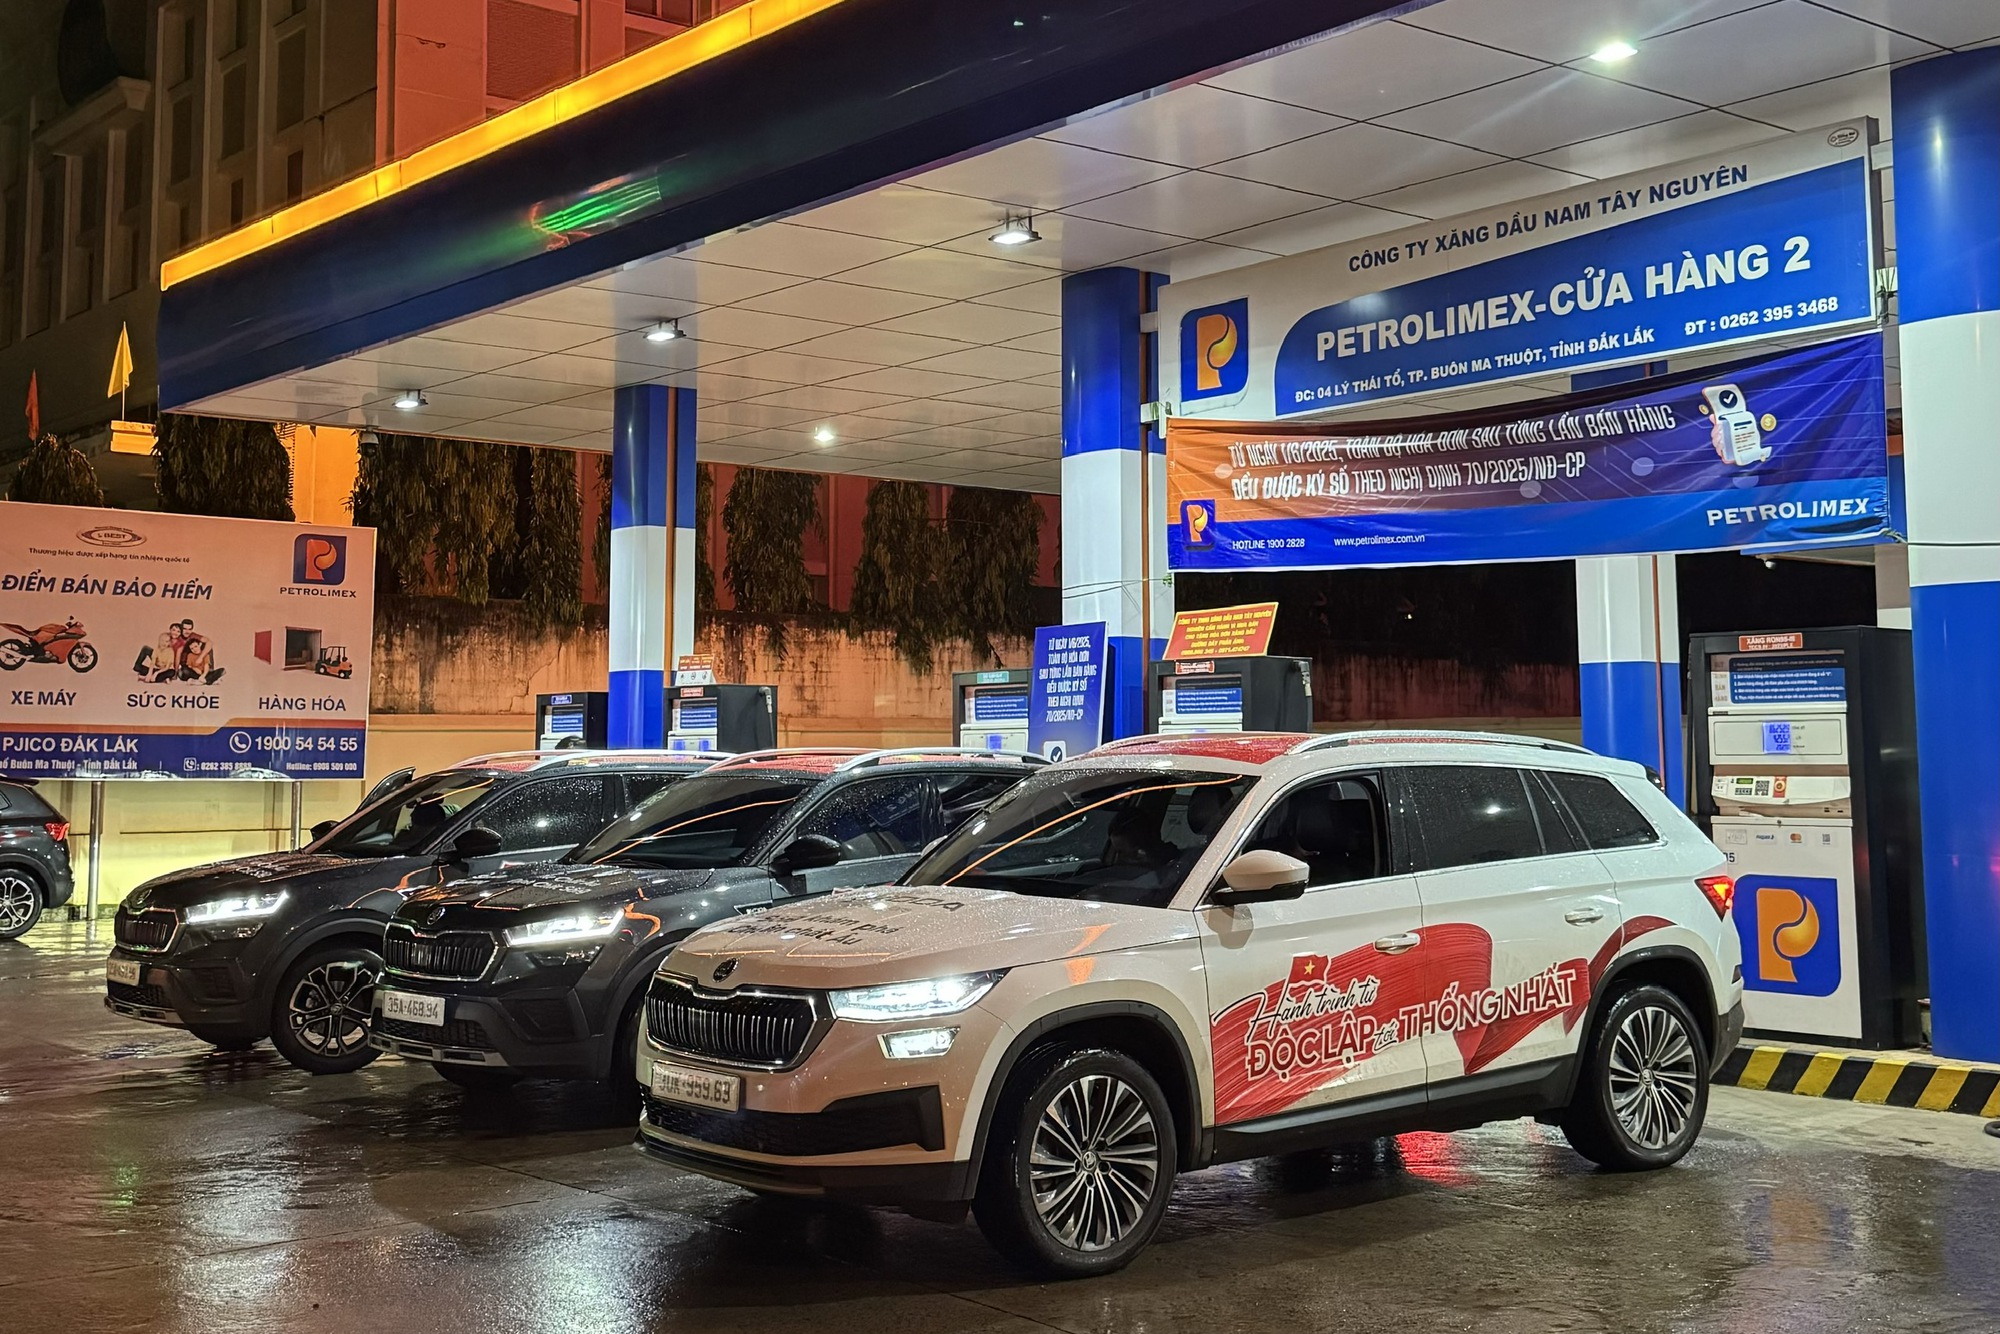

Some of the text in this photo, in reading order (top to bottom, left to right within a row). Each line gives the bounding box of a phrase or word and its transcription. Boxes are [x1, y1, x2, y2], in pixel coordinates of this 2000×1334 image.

[1349, 165, 1747, 272] CÔNG TY XĂNG DẦU NAM TÂY NGUYÊN
[1317, 236, 1811, 361] PETROLIMEX-CỬA HÀNG 2
[1685, 320, 1706, 335] ĐT
[1719, 311, 1759, 330] 0262
[1763, 305, 1793, 323] 395
[1797, 297, 1838, 317] 3468
[1295, 325, 1654, 402] ĐC: 04 LÝ THÁI TỔ, TP. BUÔN MA THUỘT, TỈNH ĐẮK LẮK
[1228, 442, 1246, 468] TỪ
[1246, 441, 1280, 466] NGÀY
[1280, 440, 1343, 464] 1/6/2025,
[1346, 436, 1380, 459] TOÀN
[1472, 425, 1501, 448] SAU
[1505, 420, 1546, 445] TỪNG
[1548, 412, 1583, 441] LẦN
[1584, 409, 1623, 438] BÁN
[1623, 404, 1676, 433] HÀNG
[1232, 452, 1586, 501] ĐỀU ĐƯỢC KÝ SỐ THEO NGHỊ ĐỊNH 70/2025/NĐ-CP
[1706, 498, 1870, 526] PETROLIMEX
[1233, 538, 1305, 550] HOTLINE 1900 2828
[1334, 535, 1425, 547] www.petrolimex.com.vn
[1, 569, 213, 600] ĐIỂM BÁN BẢO HIỂM
[280, 587, 356, 598] PETROLIMEX
[11, 689, 77, 706] XE MÁY
[127, 691, 220, 709] SỨC KHỎE
[259, 694, 346, 712] HÀNG HÓA
[3, 737, 56, 752] PJICO
[255, 736, 358, 751] 1900 54 54 55
[10, 759, 33, 769] Buôn
[35, 760, 50, 769] Ma
[51, 758, 75, 771] Thuột
[83, 758, 102, 770] Tỉnh
[1315, 980, 1357, 1016] trình
[1359, 977, 1379, 1004] từ
[1246, 963, 1576, 1082] ĐỘC LẬP tới THỐNG NHẤT
